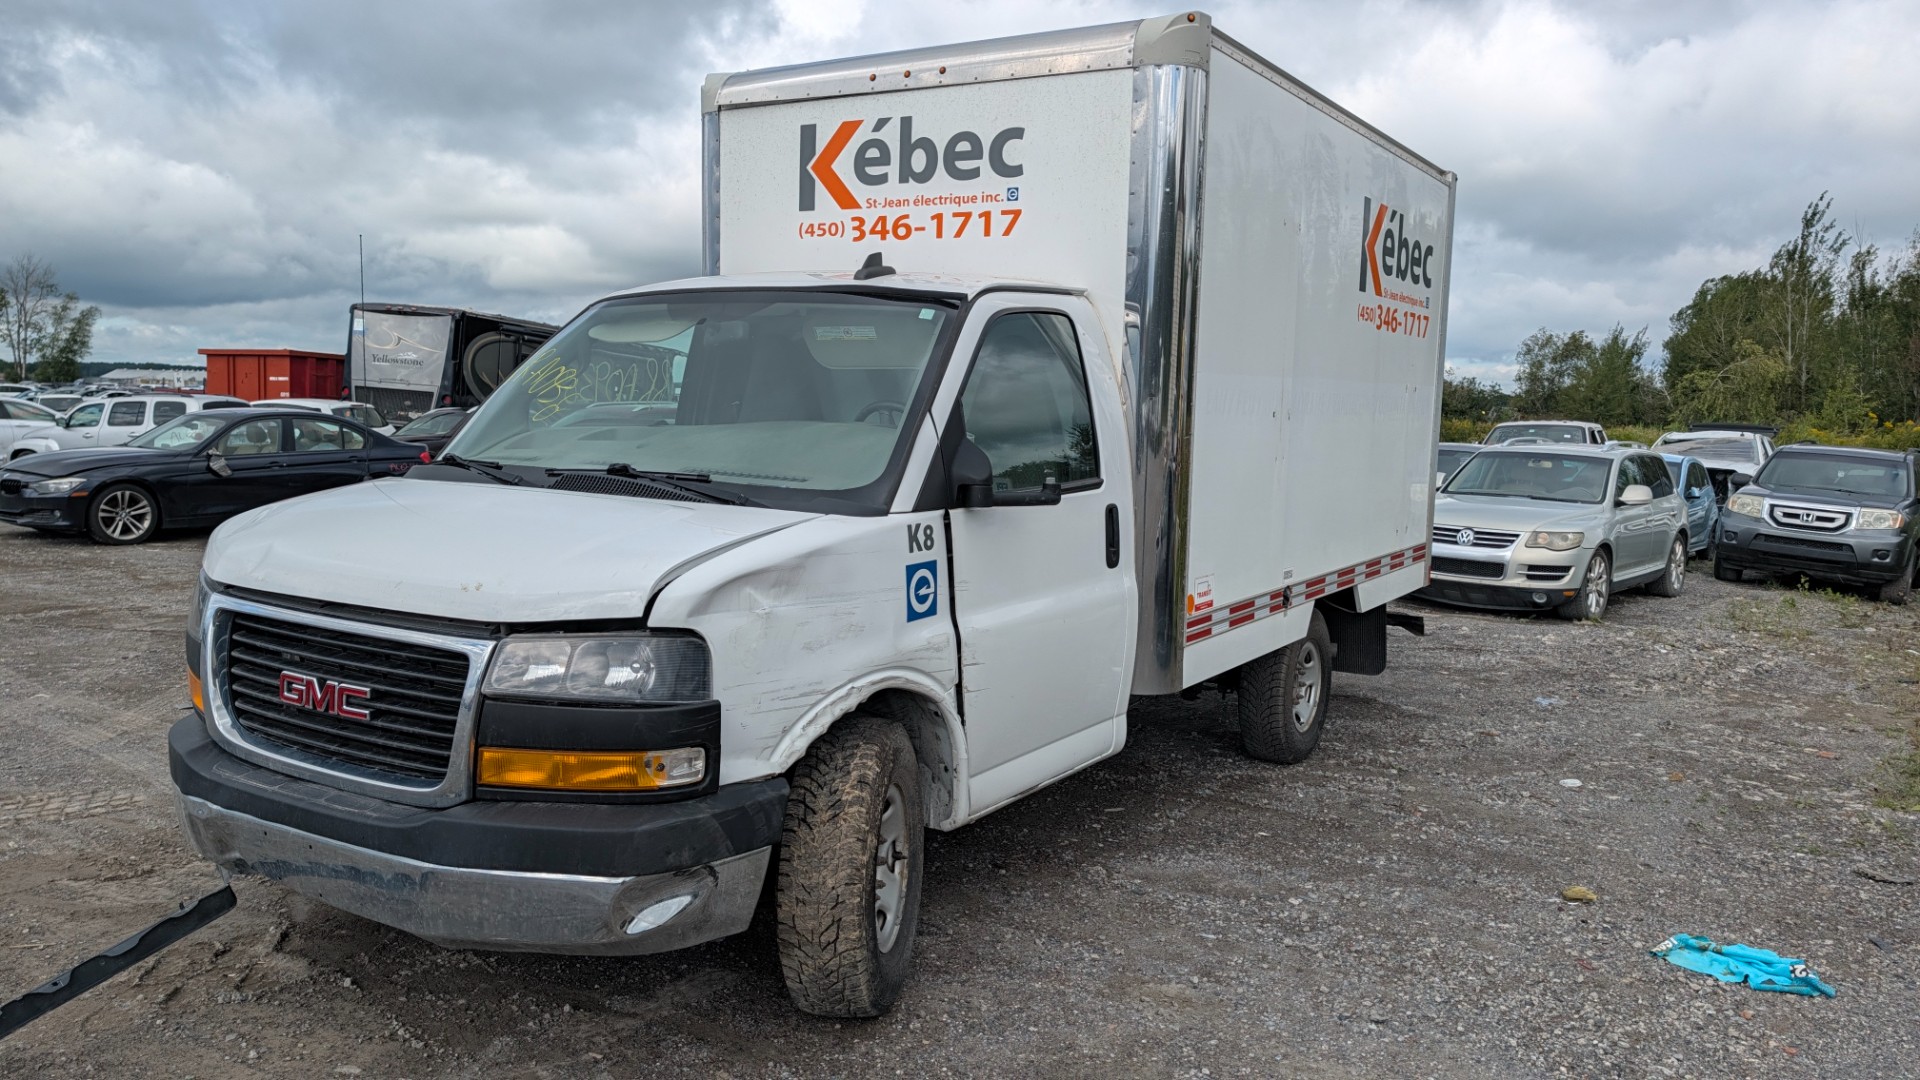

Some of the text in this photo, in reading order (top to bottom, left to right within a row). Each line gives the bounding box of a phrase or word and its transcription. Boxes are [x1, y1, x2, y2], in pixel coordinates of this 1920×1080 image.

[799, 115, 1025, 212] Kébec
[865, 191, 1004, 209] St-Jean électrique inc.
[798, 209, 1023, 242] (450) 346-1717
[1359, 196, 1434, 297] Kébec
[1357, 303, 1430, 339] (450) 346-1717
[371, 353, 424, 367] Yellowstone
[906, 522, 935, 554] K8
[279, 670, 372, 721] GMC
